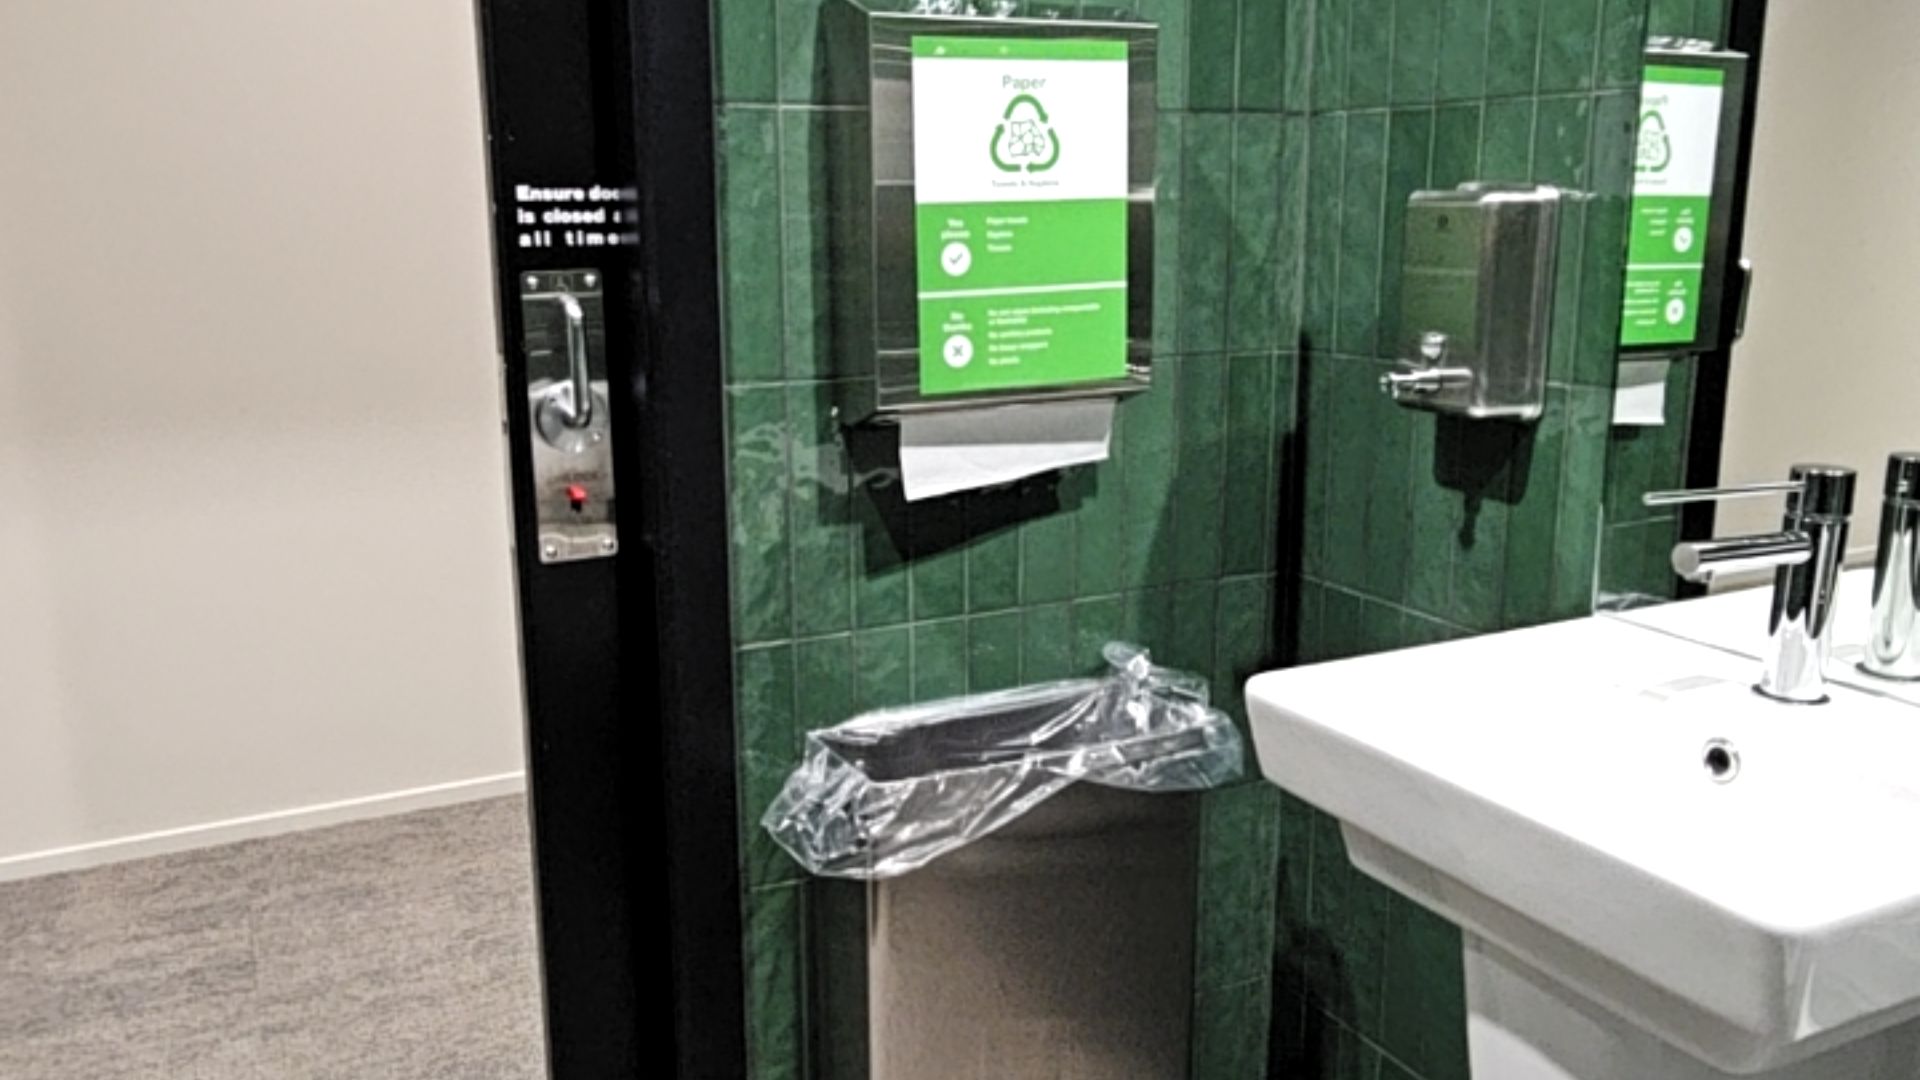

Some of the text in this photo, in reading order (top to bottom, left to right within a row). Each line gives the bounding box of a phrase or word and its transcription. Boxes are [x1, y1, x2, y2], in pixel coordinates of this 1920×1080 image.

[1001, 75, 1047, 91] Paper
[515, 185, 585, 202] Ensure
[517, 206, 536, 223] is
[542, 206, 606, 223] closed
[519, 230, 622, 247] all time
